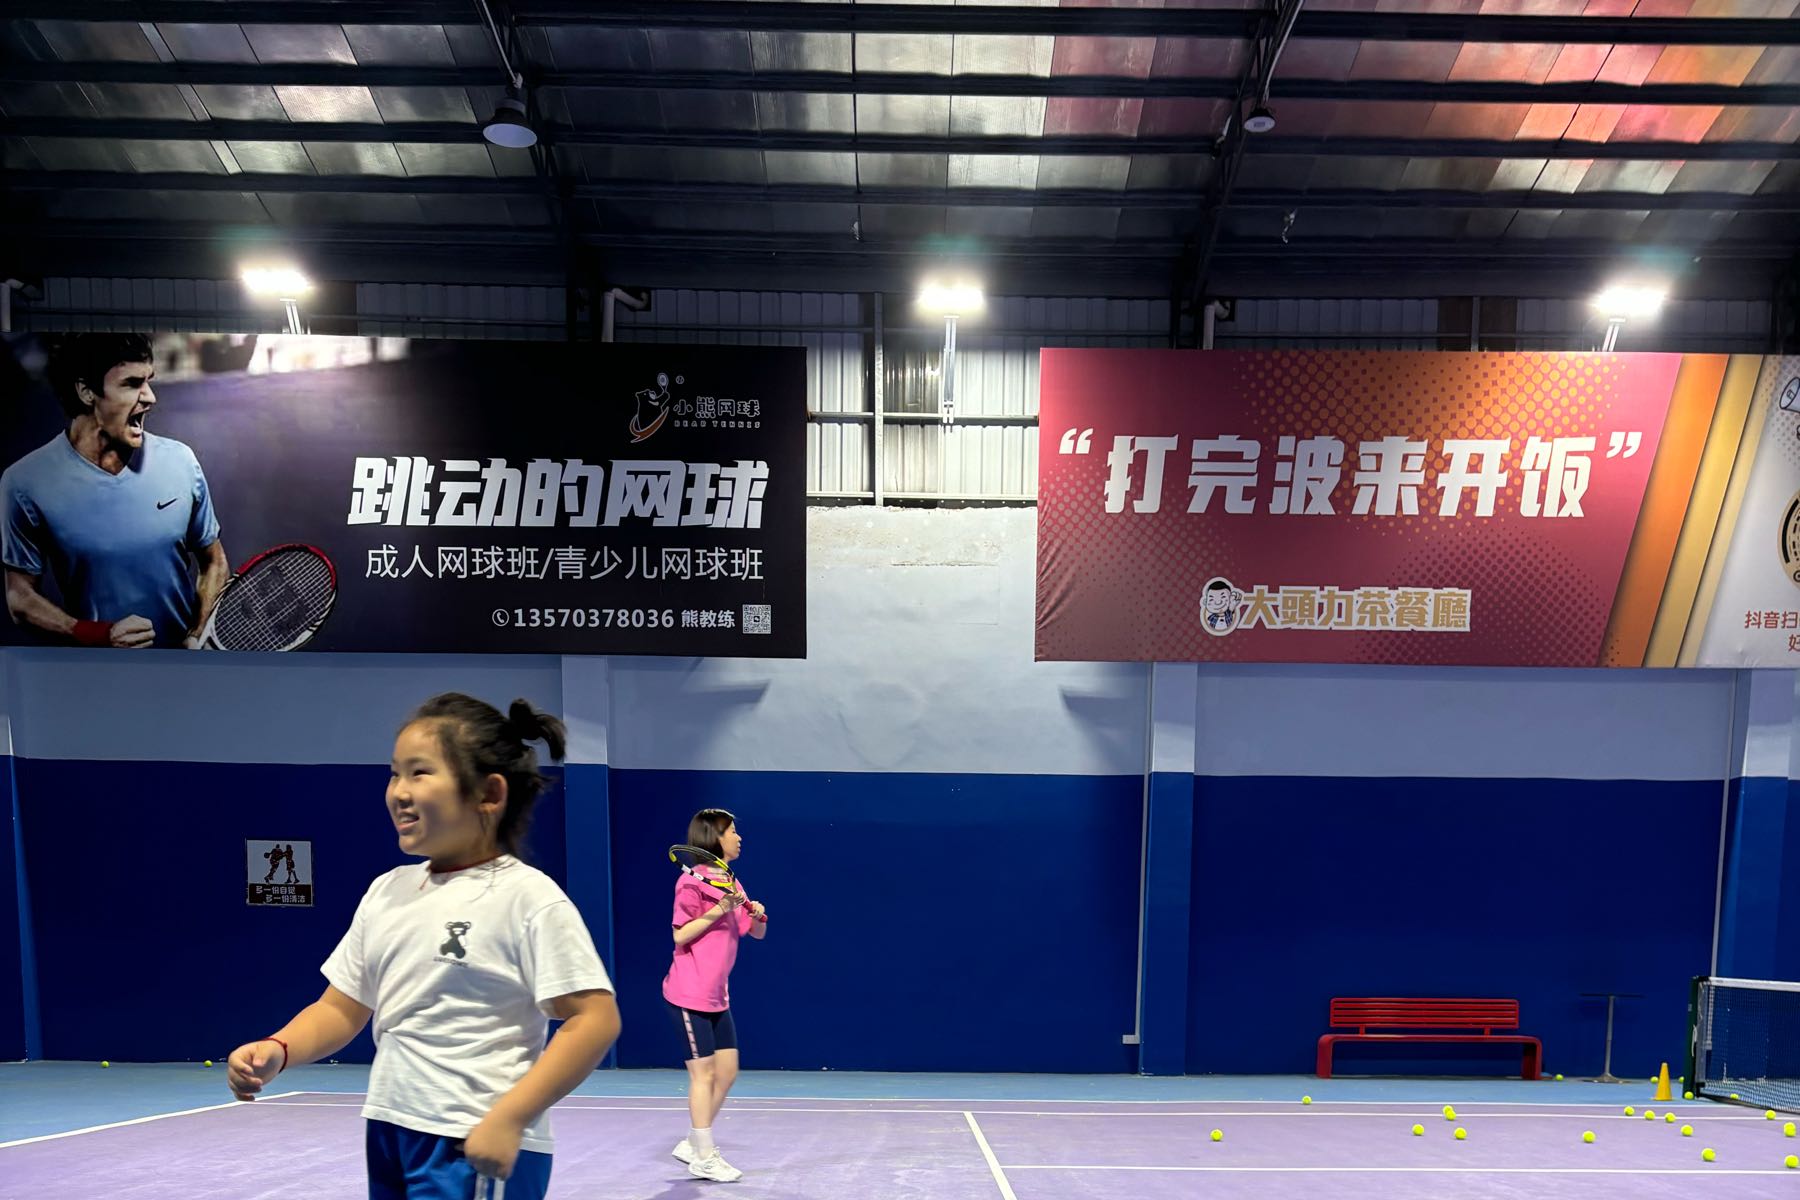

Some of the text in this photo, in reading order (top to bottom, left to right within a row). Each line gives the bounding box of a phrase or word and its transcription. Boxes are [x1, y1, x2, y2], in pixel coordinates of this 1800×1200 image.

[673, 396, 760, 418] 小熊网球
[712, 420, 760, 429] TENNIS
[347, 456, 769, 529] 跳动的网球
[365, 544, 764, 581] 成人网球班/青少儿网球班
[513, 608, 736, 630] 13570378036 熊教练
[1242, 588, 1469, 629] 大頭力茶餐廳
